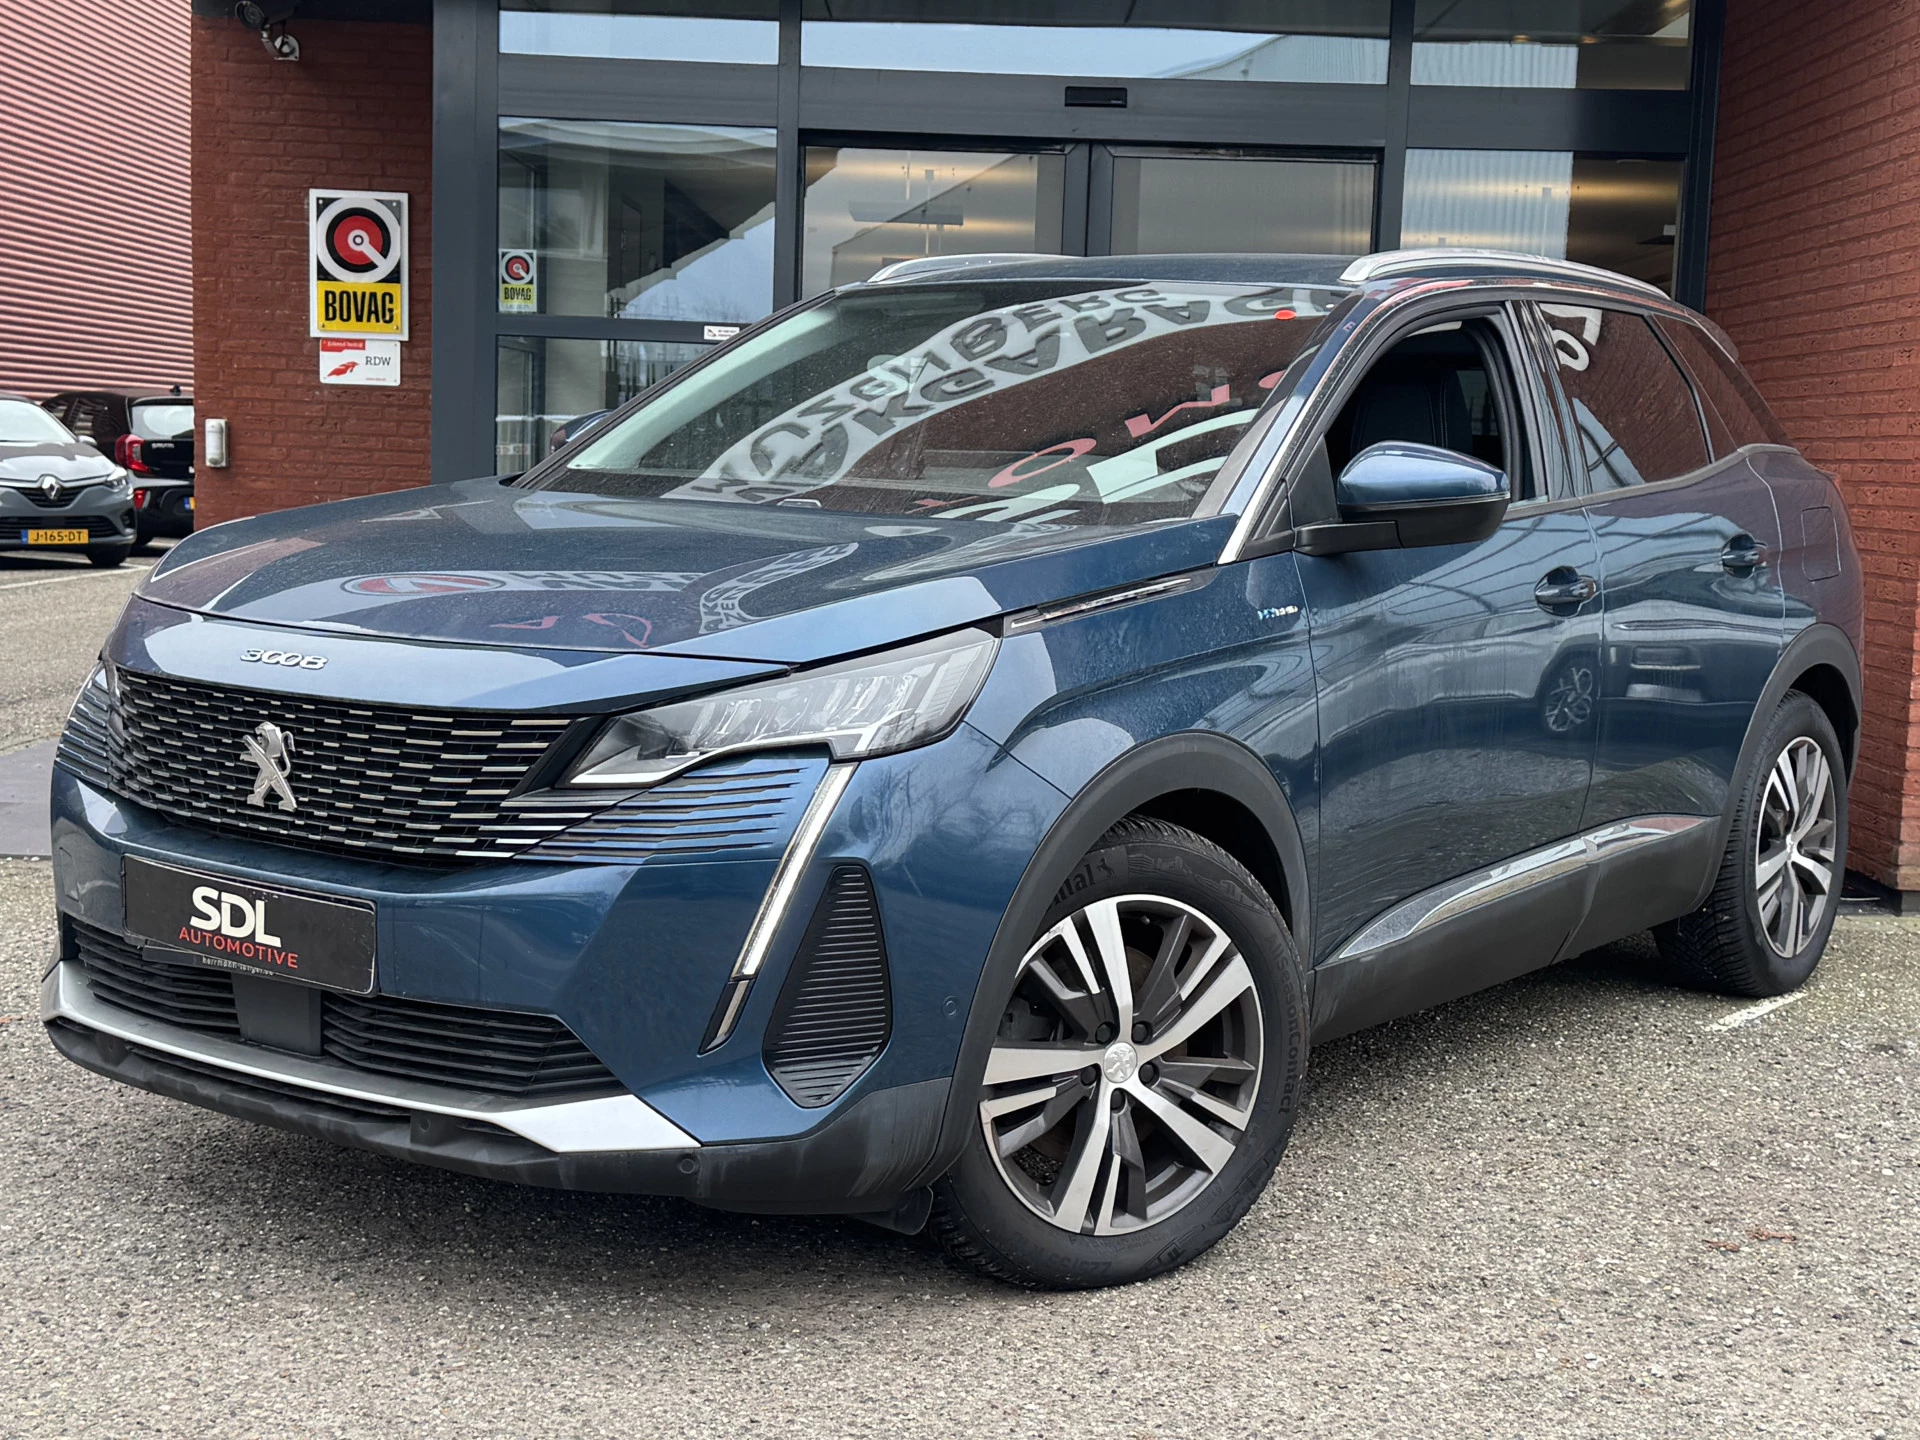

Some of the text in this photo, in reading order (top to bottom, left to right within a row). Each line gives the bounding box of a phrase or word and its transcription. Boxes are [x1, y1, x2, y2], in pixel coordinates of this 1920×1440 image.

[504, 287, 532, 301] BOVAG
[324, 290, 394, 324] BOVAG
[365, 356, 391, 366] RDW
[34, 531, 83, 542] J-165-DT
[240, 648, 329, 670] 3008
[190, 886, 282, 948] SDL
[179, 926, 299, 969] AUTOMOTIVE
